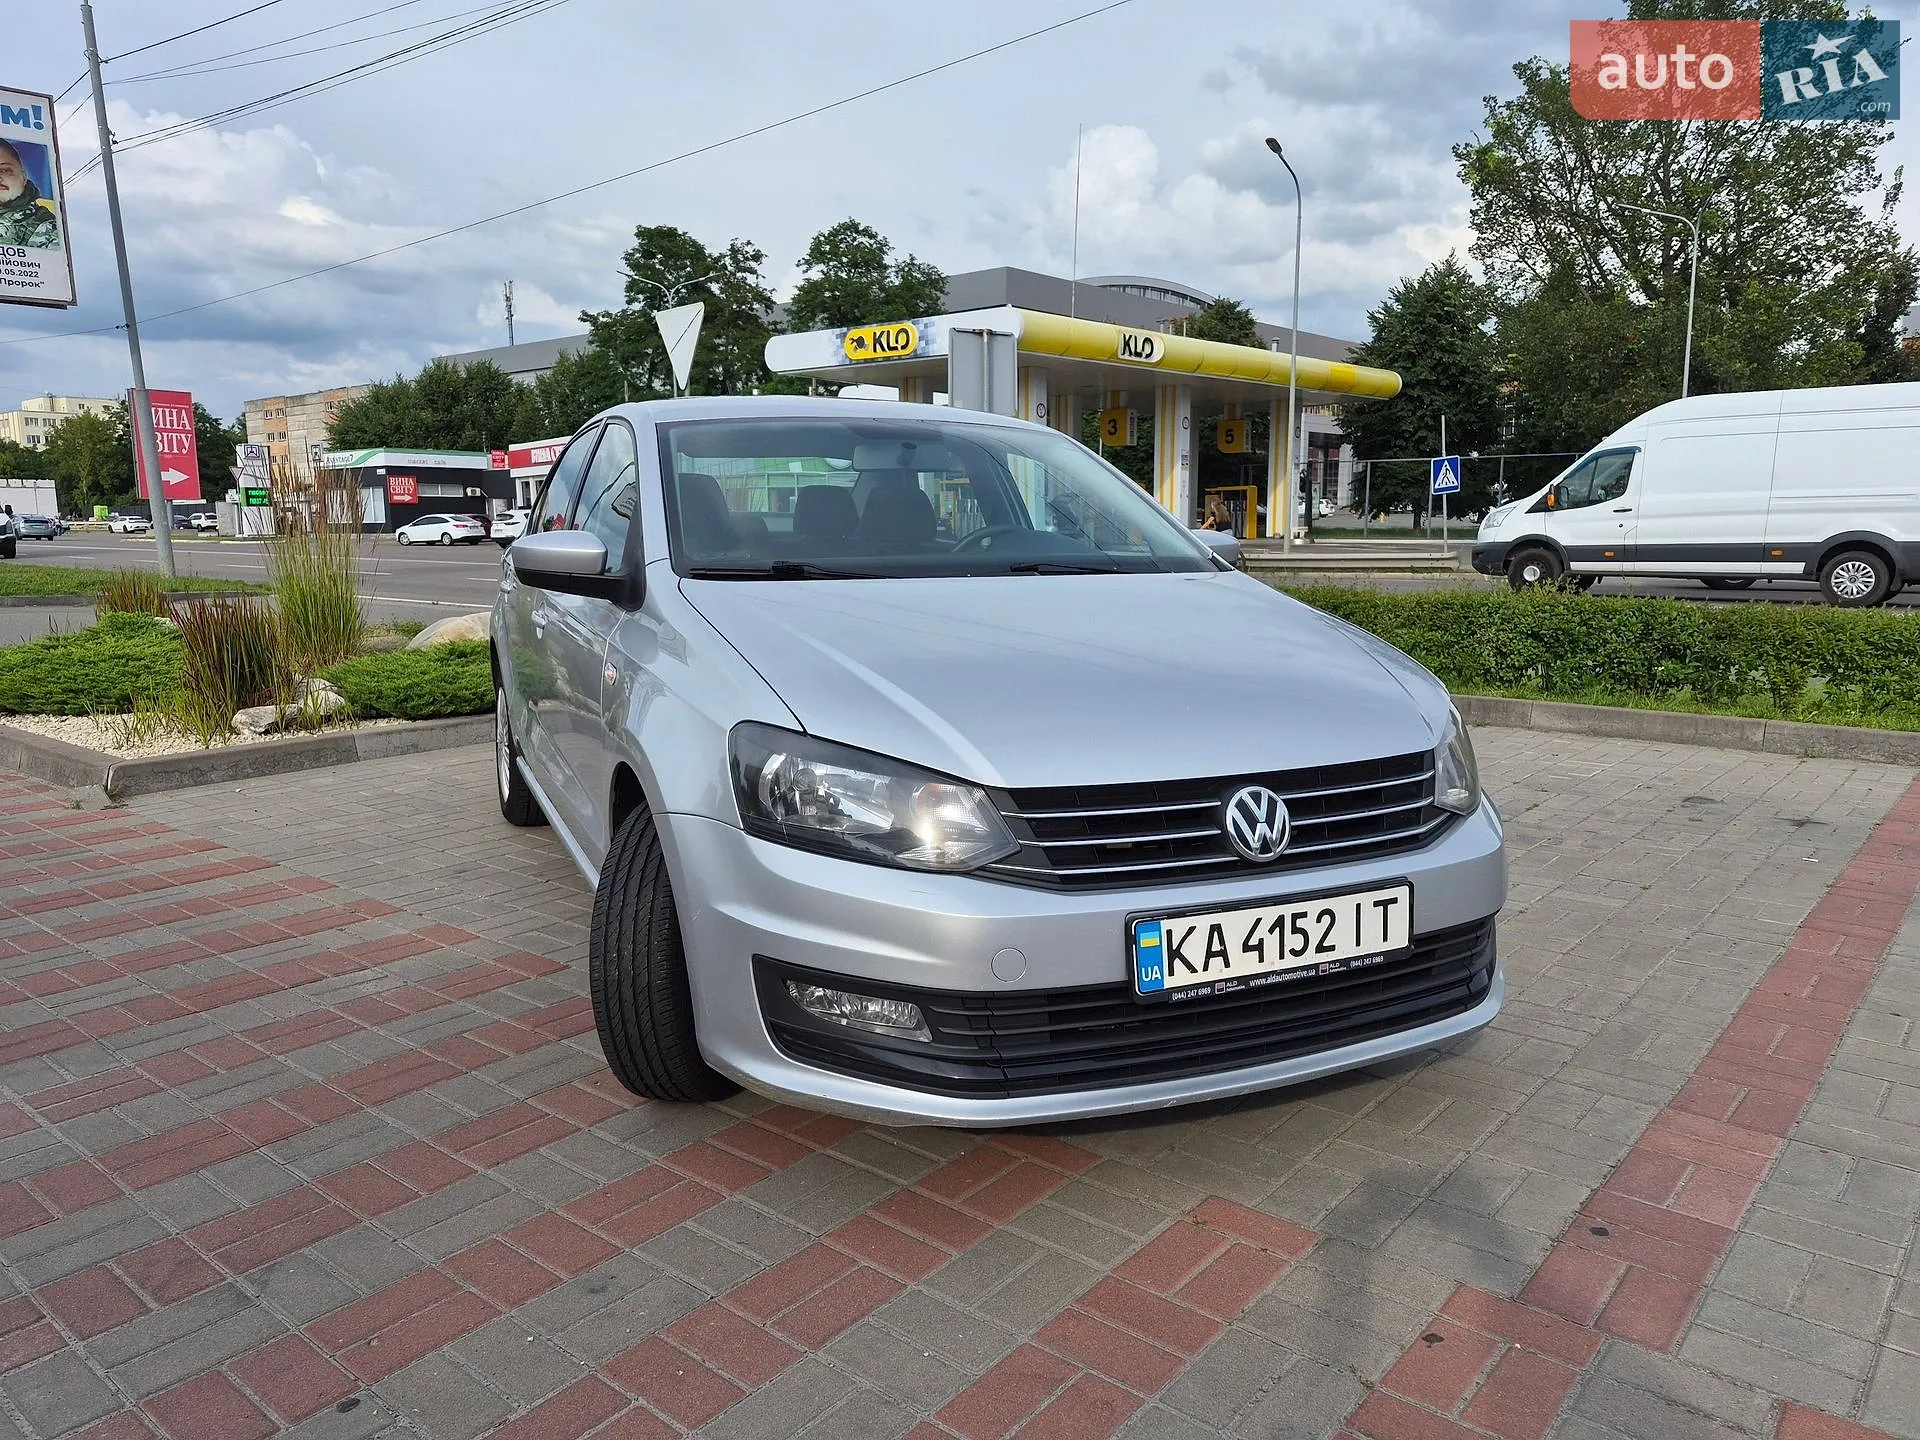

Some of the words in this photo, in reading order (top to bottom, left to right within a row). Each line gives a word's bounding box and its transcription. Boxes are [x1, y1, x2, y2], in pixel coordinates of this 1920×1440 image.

[873, 328, 910, 353] KLO
[1121, 333, 1154, 358] KLO
[1107, 419, 1117, 435] 3
[1225, 429, 1234, 444] 5
[390, 477, 414, 485] ВИНА
[390, 486, 414, 494] СВІТУ
[1165, 923, 1231, 977] KA
[1241, 908, 1336, 964] 4152
[1355, 896, 1398, 948] IT
[1142, 965, 1161, 981] UA
